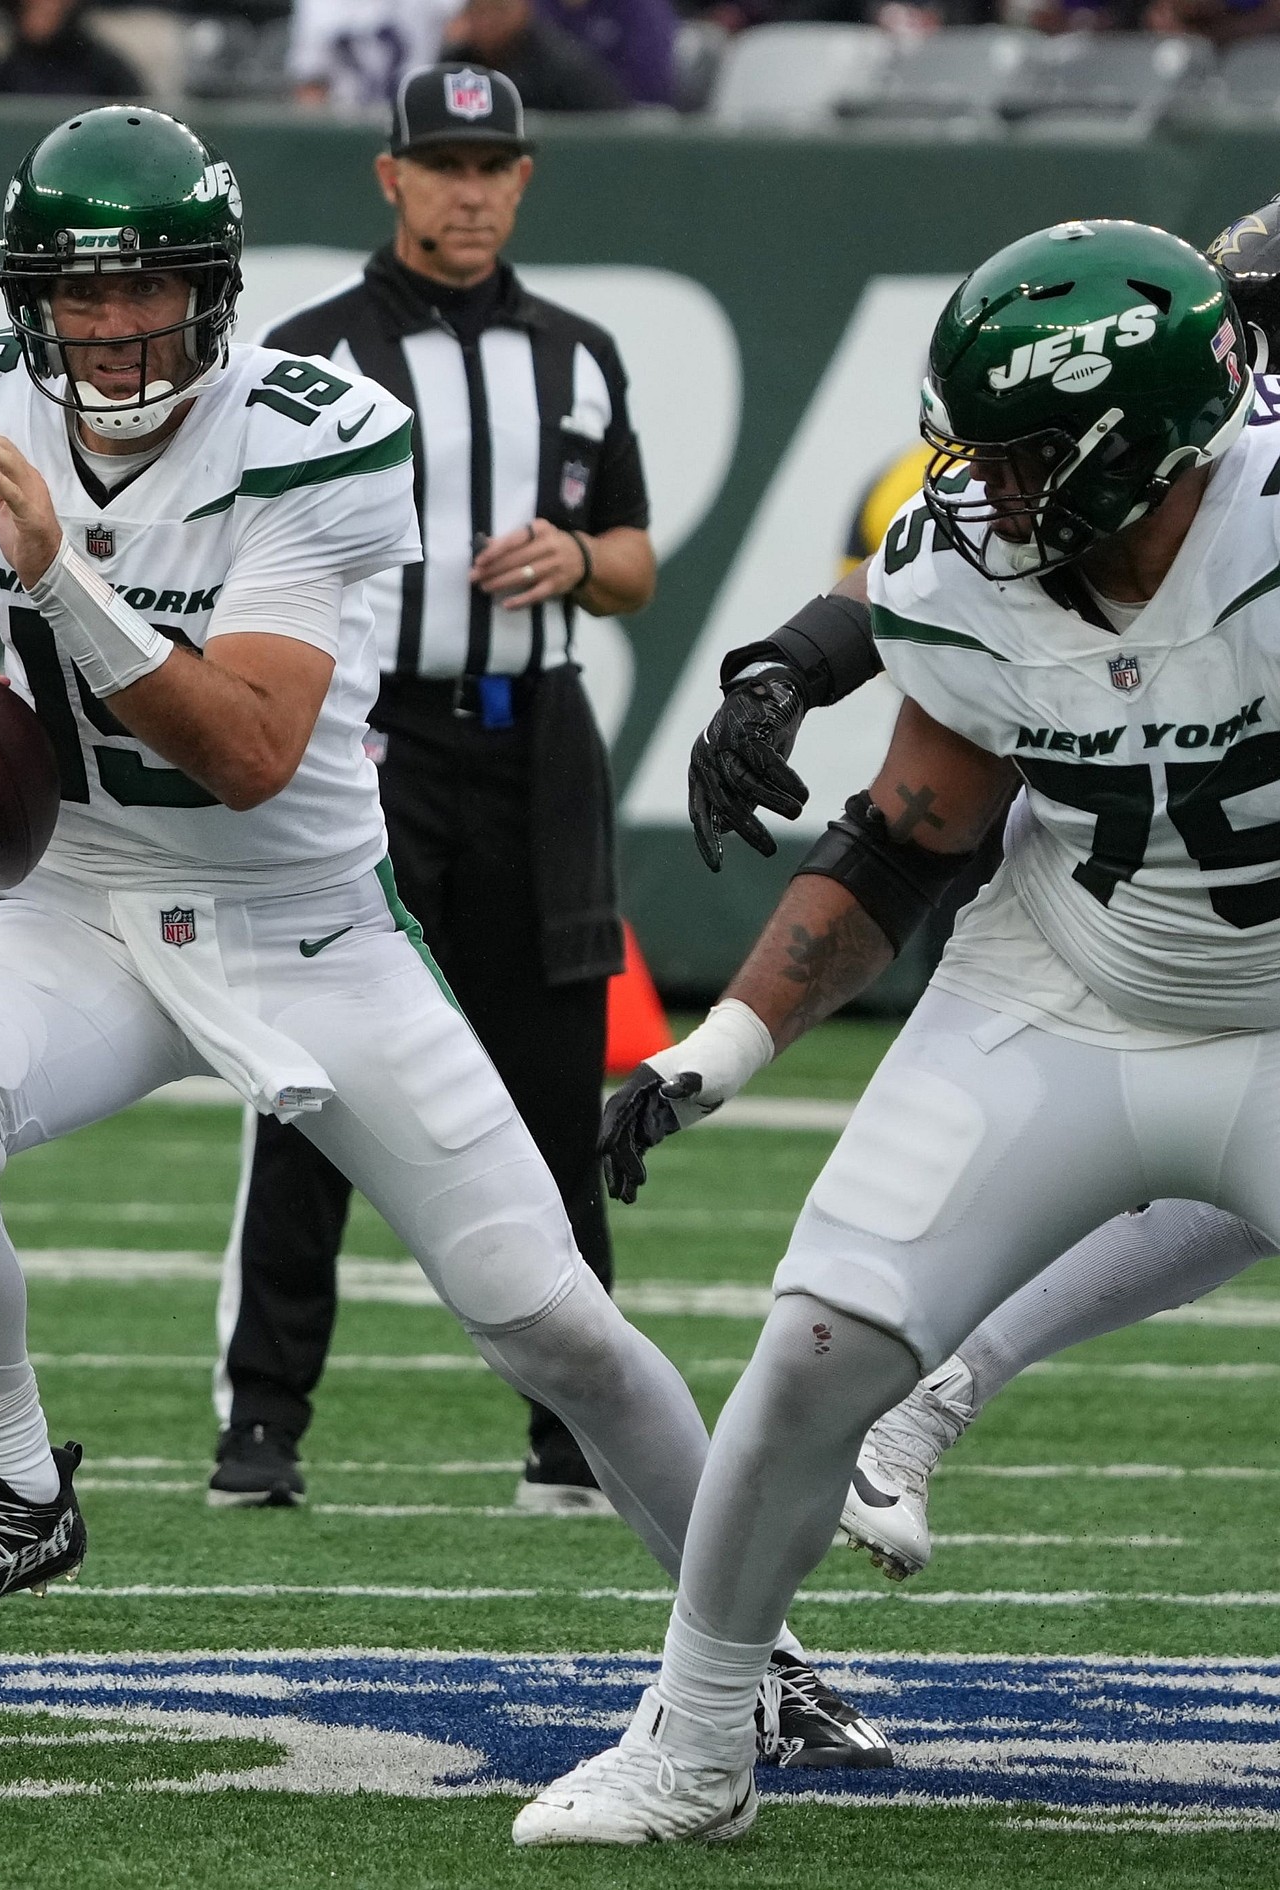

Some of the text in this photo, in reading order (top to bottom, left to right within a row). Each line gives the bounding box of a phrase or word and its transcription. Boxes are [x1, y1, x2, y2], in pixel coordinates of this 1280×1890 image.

[194, 161, 238, 202] JE
[76, 235, 118, 248] JETS
[988, 304, 1158, 391] JETS
[245, 360, 353, 427] 19
[90, 540, 111, 555] NFL
[1113, 669, 1138, 687] NFL
[1016, 696, 1266, 758] NEW YORK
[164, 923, 193, 943] NFL
